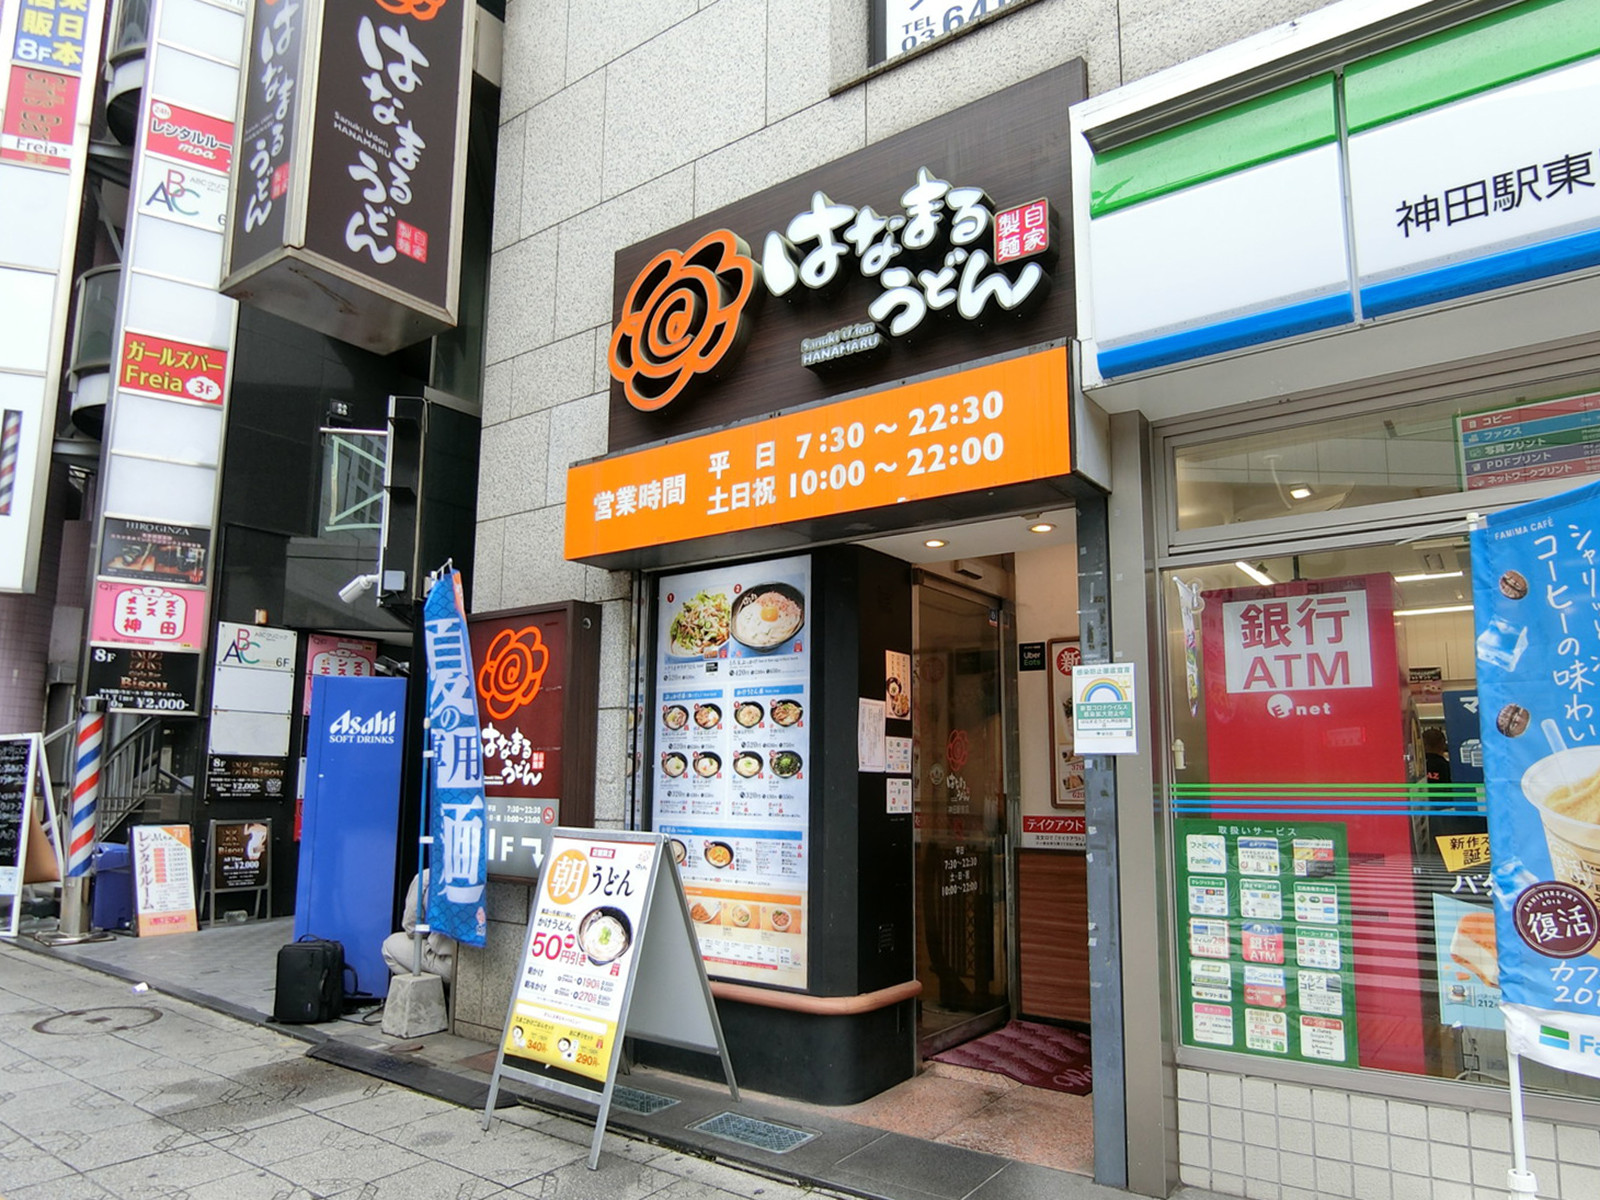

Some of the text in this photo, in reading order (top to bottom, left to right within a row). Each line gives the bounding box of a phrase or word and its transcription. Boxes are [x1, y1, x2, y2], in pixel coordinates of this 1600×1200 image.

[902, 16, 936, 35] TEL
[17, 38, 52, 62] 8F
[357, 15, 431, 205] はなまる
[16, 137, 58, 156] Freia
[332, 120, 393, 160] HANAMARU
[145, 168, 201, 216] ABC
[1395, 150, 1597, 239] 神田駅東
[345, 150, 398, 265] うどん
[761, 166, 997, 298] はなまる
[867, 247, 1044, 338] うどん
[126, 339, 224, 372] ガールズバー
[802, 335, 880, 365] HANAMARU
[125, 364, 214, 396] Freia 3F
[1482, 413, 1512, 427] コピー
[593, 474, 687, 522] 営業時間
[796, 421, 866, 461] 7:30
[907, 390, 1005, 436] 22:30
[1485, 452, 1552, 470] PDFプリント
[706, 476, 777, 517] 土日祝
[789, 457, 866, 499] 10:00
[906, 432, 1005, 478] 22:00
[1487, 464, 1573, 485] ネットワークプリント
[1494, 525, 1529, 541] FAMIMA
[123, 617, 178, 636] 神田
[1239, 595, 1350, 650] 銀行
[222, 628, 261, 665] ABC
[1534, 534, 1597, 742] コーヒーの味わい
[94, 647, 117, 663] 8F
[275, 657, 290, 668] 6F
[1023, 651, 1041, 659] Uber
[1023, 658, 1041, 667] Eats
[1242, 651, 1350, 690] ATM
[1296, 701, 1331, 716] net
[329, 710, 397, 736] Asahi
[329, 734, 395, 745] SOFT DRINKS
[501, 758, 543, 787] うどん
[1026, 818, 1085, 832] テイクアウト
[1217, 825, 1298, 838] 取扱いサービス
[537, 917, 573, 933] かけうどん
[1527, 903, 1592, 944] 復活
[1249, 950, 1277, 962] ATM
